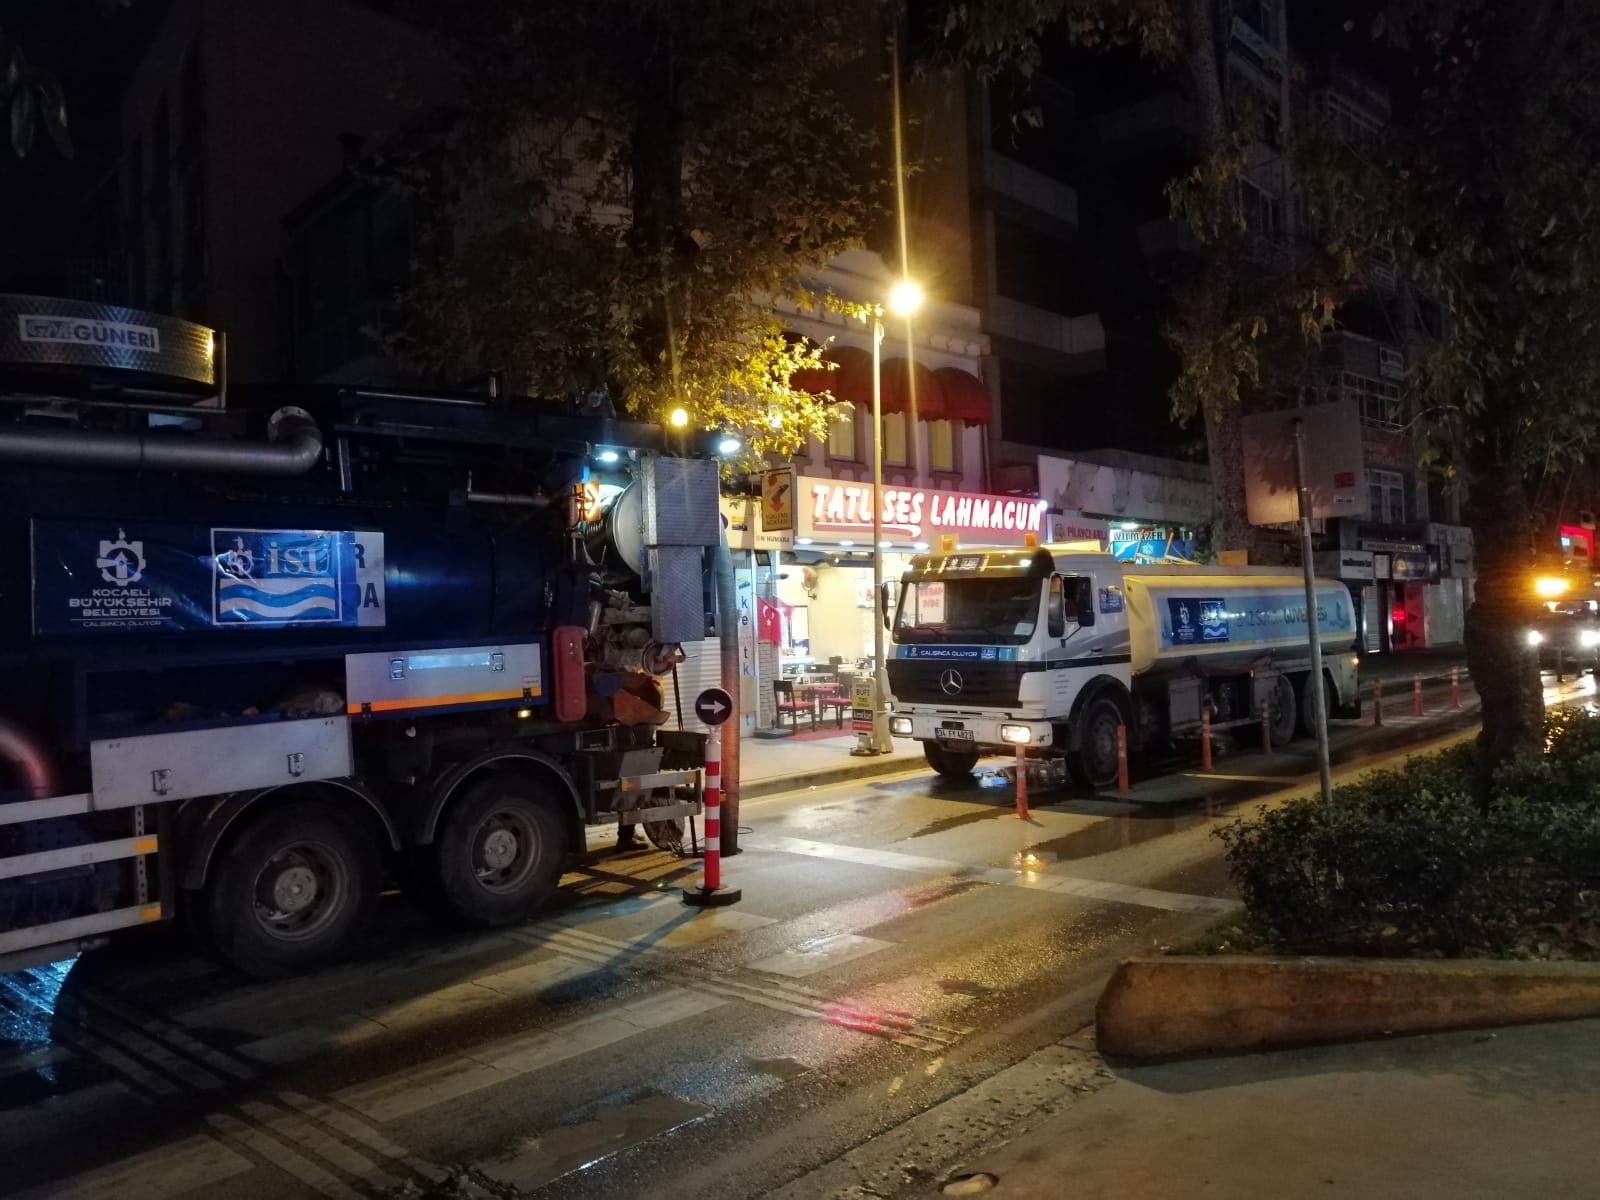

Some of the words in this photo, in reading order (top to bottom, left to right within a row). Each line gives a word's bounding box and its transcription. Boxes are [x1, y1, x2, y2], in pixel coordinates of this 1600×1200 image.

[73, 321, 156, 349] GÜNERİ
[813, 484, 925, 525] TATLSES
[930, 494, 1043, 531] LAHMACUN
[92, 588, 151, 597] KOCAELİ
[69, 597, 172, 608] BÜYÜKŞEHİR
[82, 608, 161, 617] BELEDİYESİ
